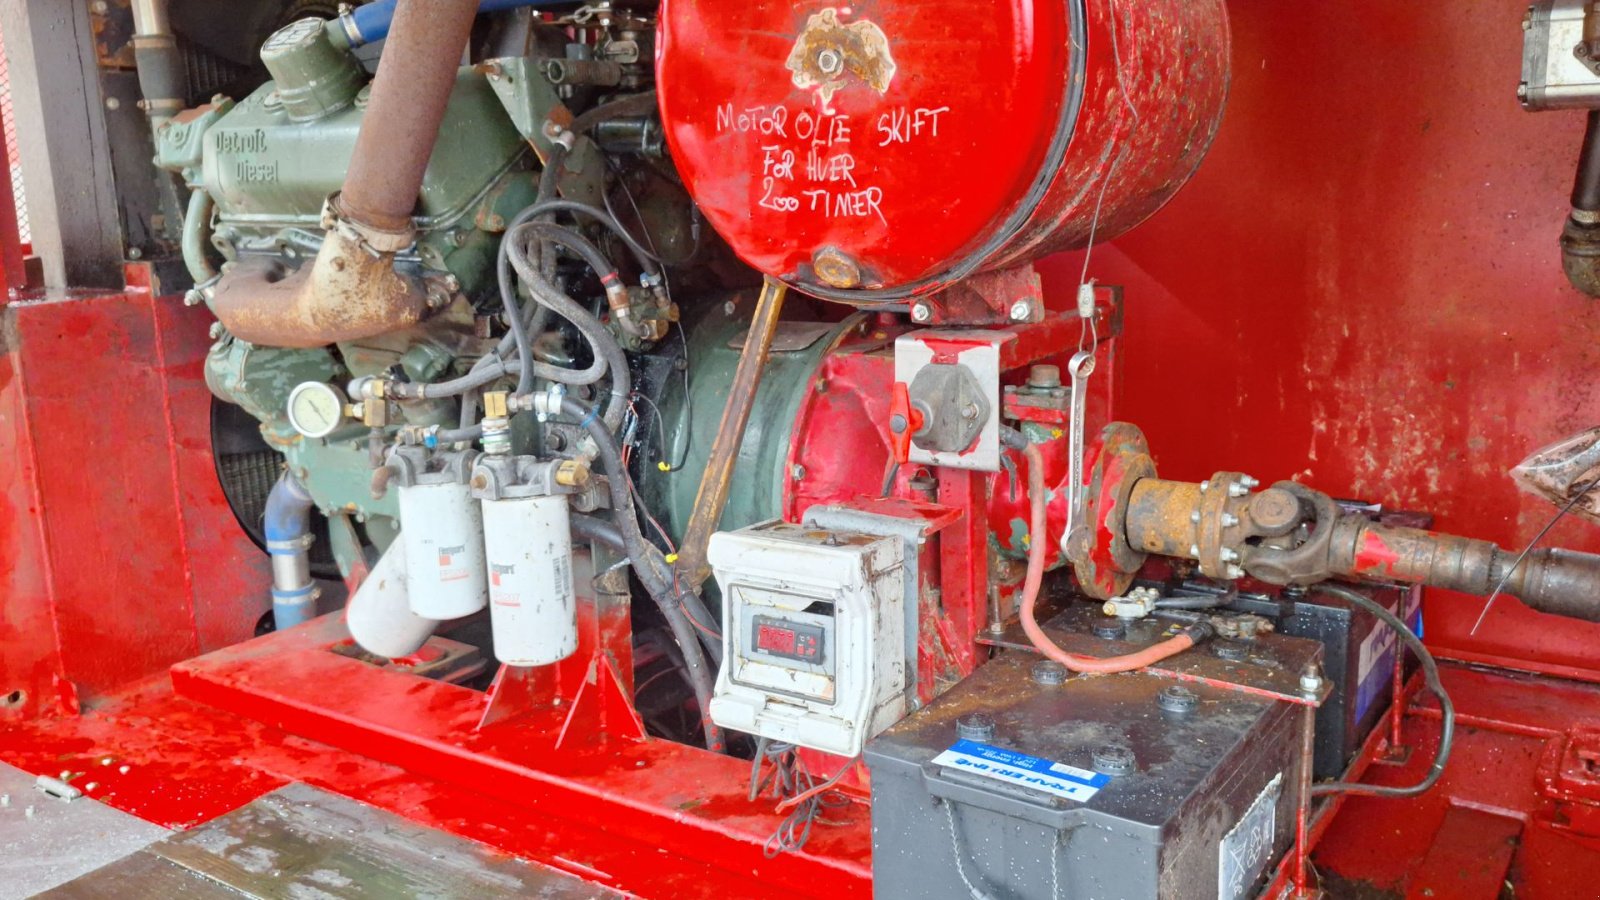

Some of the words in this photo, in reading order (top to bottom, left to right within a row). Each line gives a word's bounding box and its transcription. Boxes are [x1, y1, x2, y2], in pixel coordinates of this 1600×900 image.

[216, 128, 267, 153] Detroit
[716, 103, 787, 138] MOTOR
[795, 113, 851, 147] OLIE
[877, 106, 950, 146] SKIFT
[237, 160, 279, 183] Diesel
[761, 145, 795, 180] FOR
[758, 177, 799, 212] 200
[802, 186, 888, 226] TIMER
